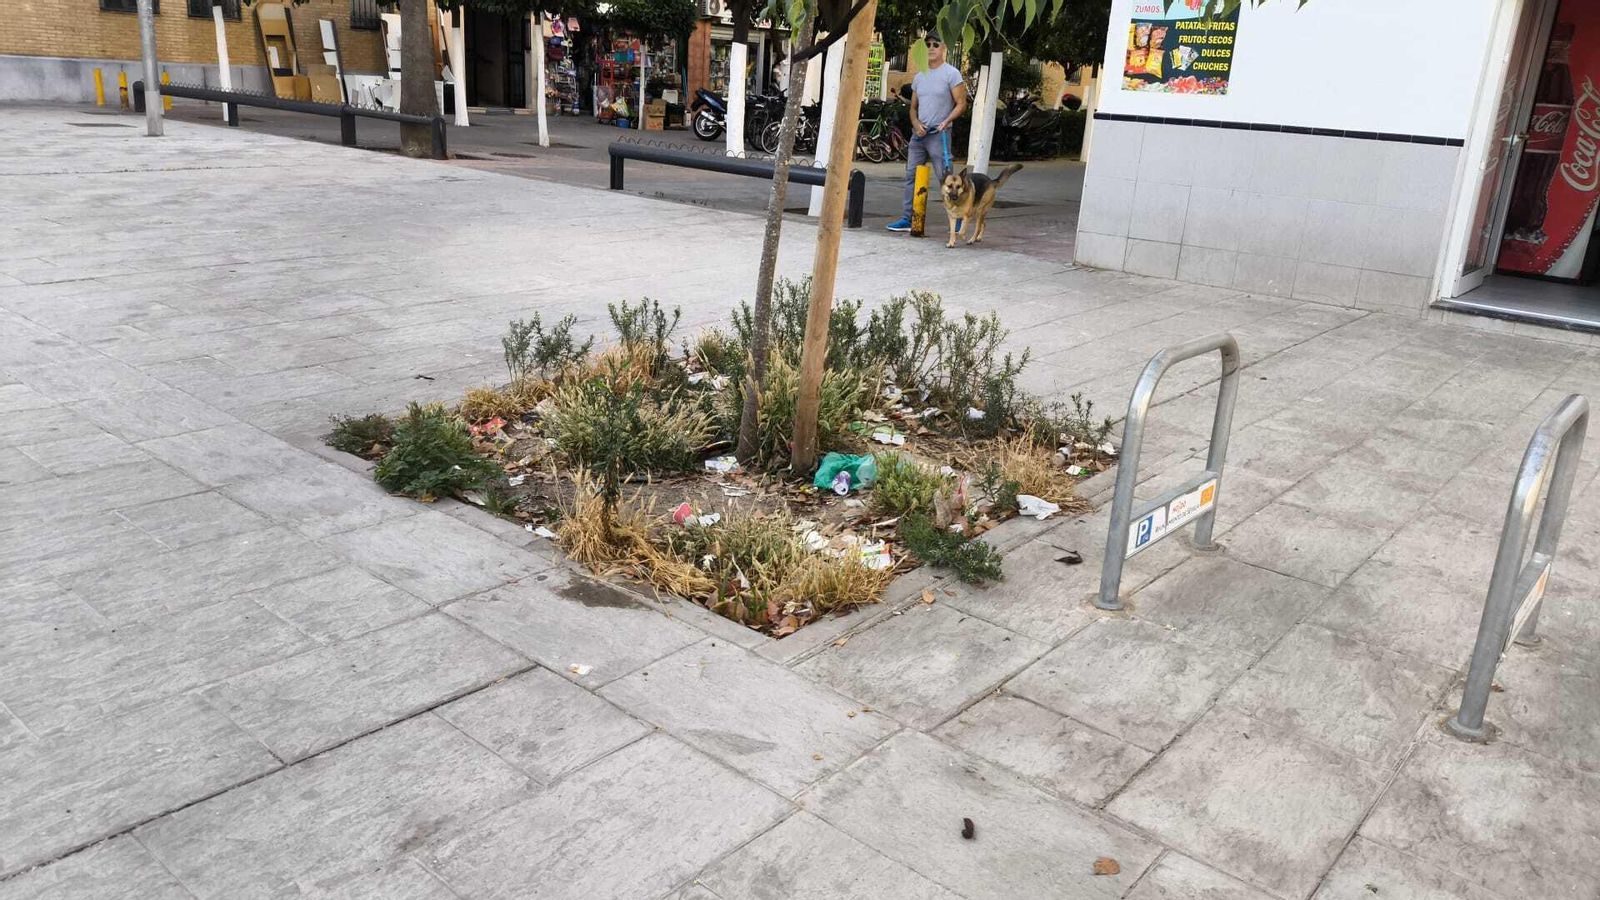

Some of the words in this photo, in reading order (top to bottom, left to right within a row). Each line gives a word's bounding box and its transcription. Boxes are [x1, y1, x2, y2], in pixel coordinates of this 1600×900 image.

[1135, 5, 1160, 13] ZUMOS
[1208, 21, 1236, 31] FRITAS
[1178, 35, 1207, 44] FRUTOS
[1207, 35, 1233, 44] SECOS
[1201, 49, 1231, 58] DULCES
[1193, 62, 1229, 71] CHUCHES
[1137, 520, 1149, 546] P
